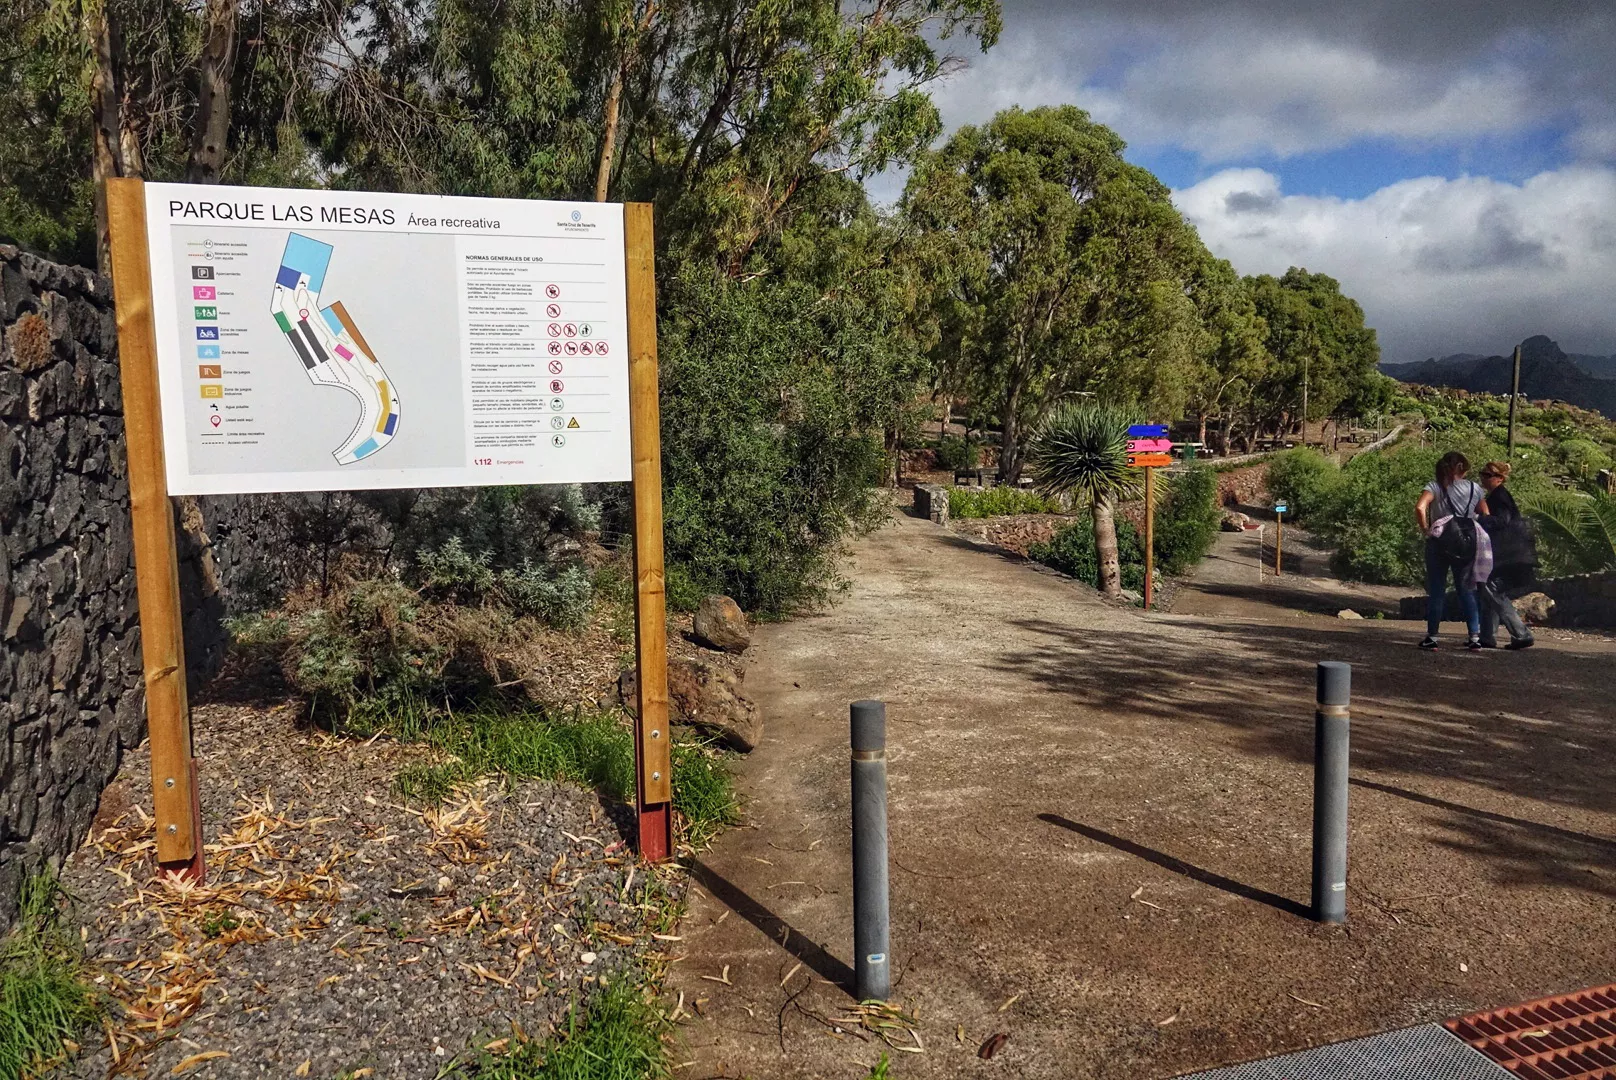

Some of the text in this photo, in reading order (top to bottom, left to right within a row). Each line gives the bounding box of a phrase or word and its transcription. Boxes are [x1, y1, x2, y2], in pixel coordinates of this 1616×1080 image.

[170, 201, 395, 225] PARQUE LAS MESAS
[408, 213, 500, 229] Área recreativa
